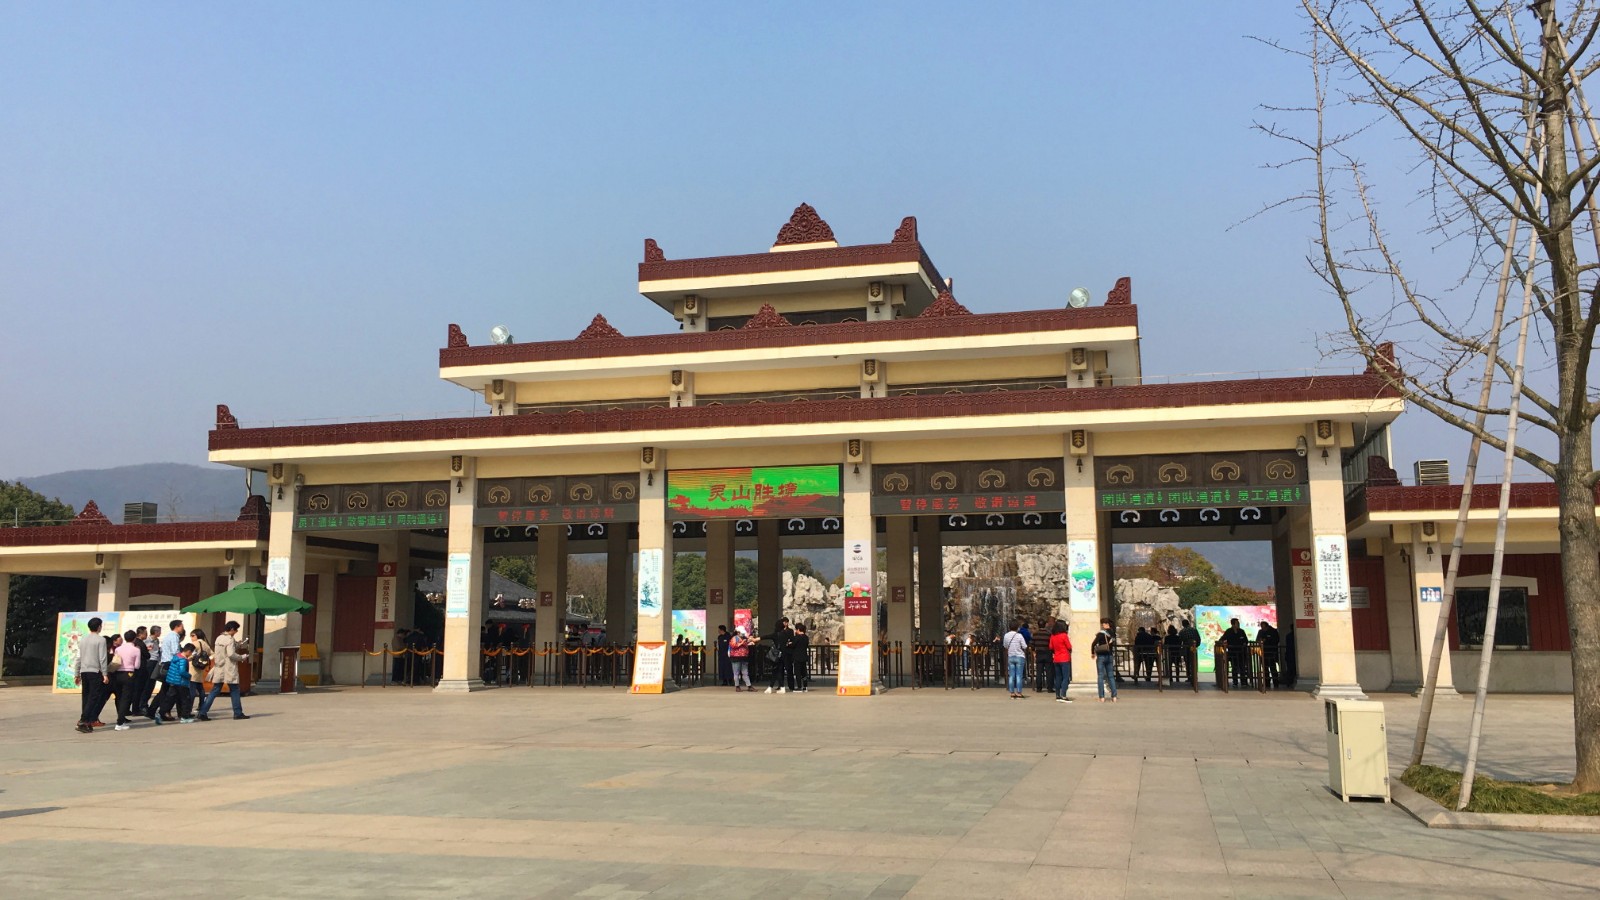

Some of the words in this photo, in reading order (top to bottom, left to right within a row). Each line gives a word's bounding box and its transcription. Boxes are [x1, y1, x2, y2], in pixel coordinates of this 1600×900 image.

[708, 482, 797, 502] 灵山胜境
[1302, 568, 1315, 617] 签单及员工通道
